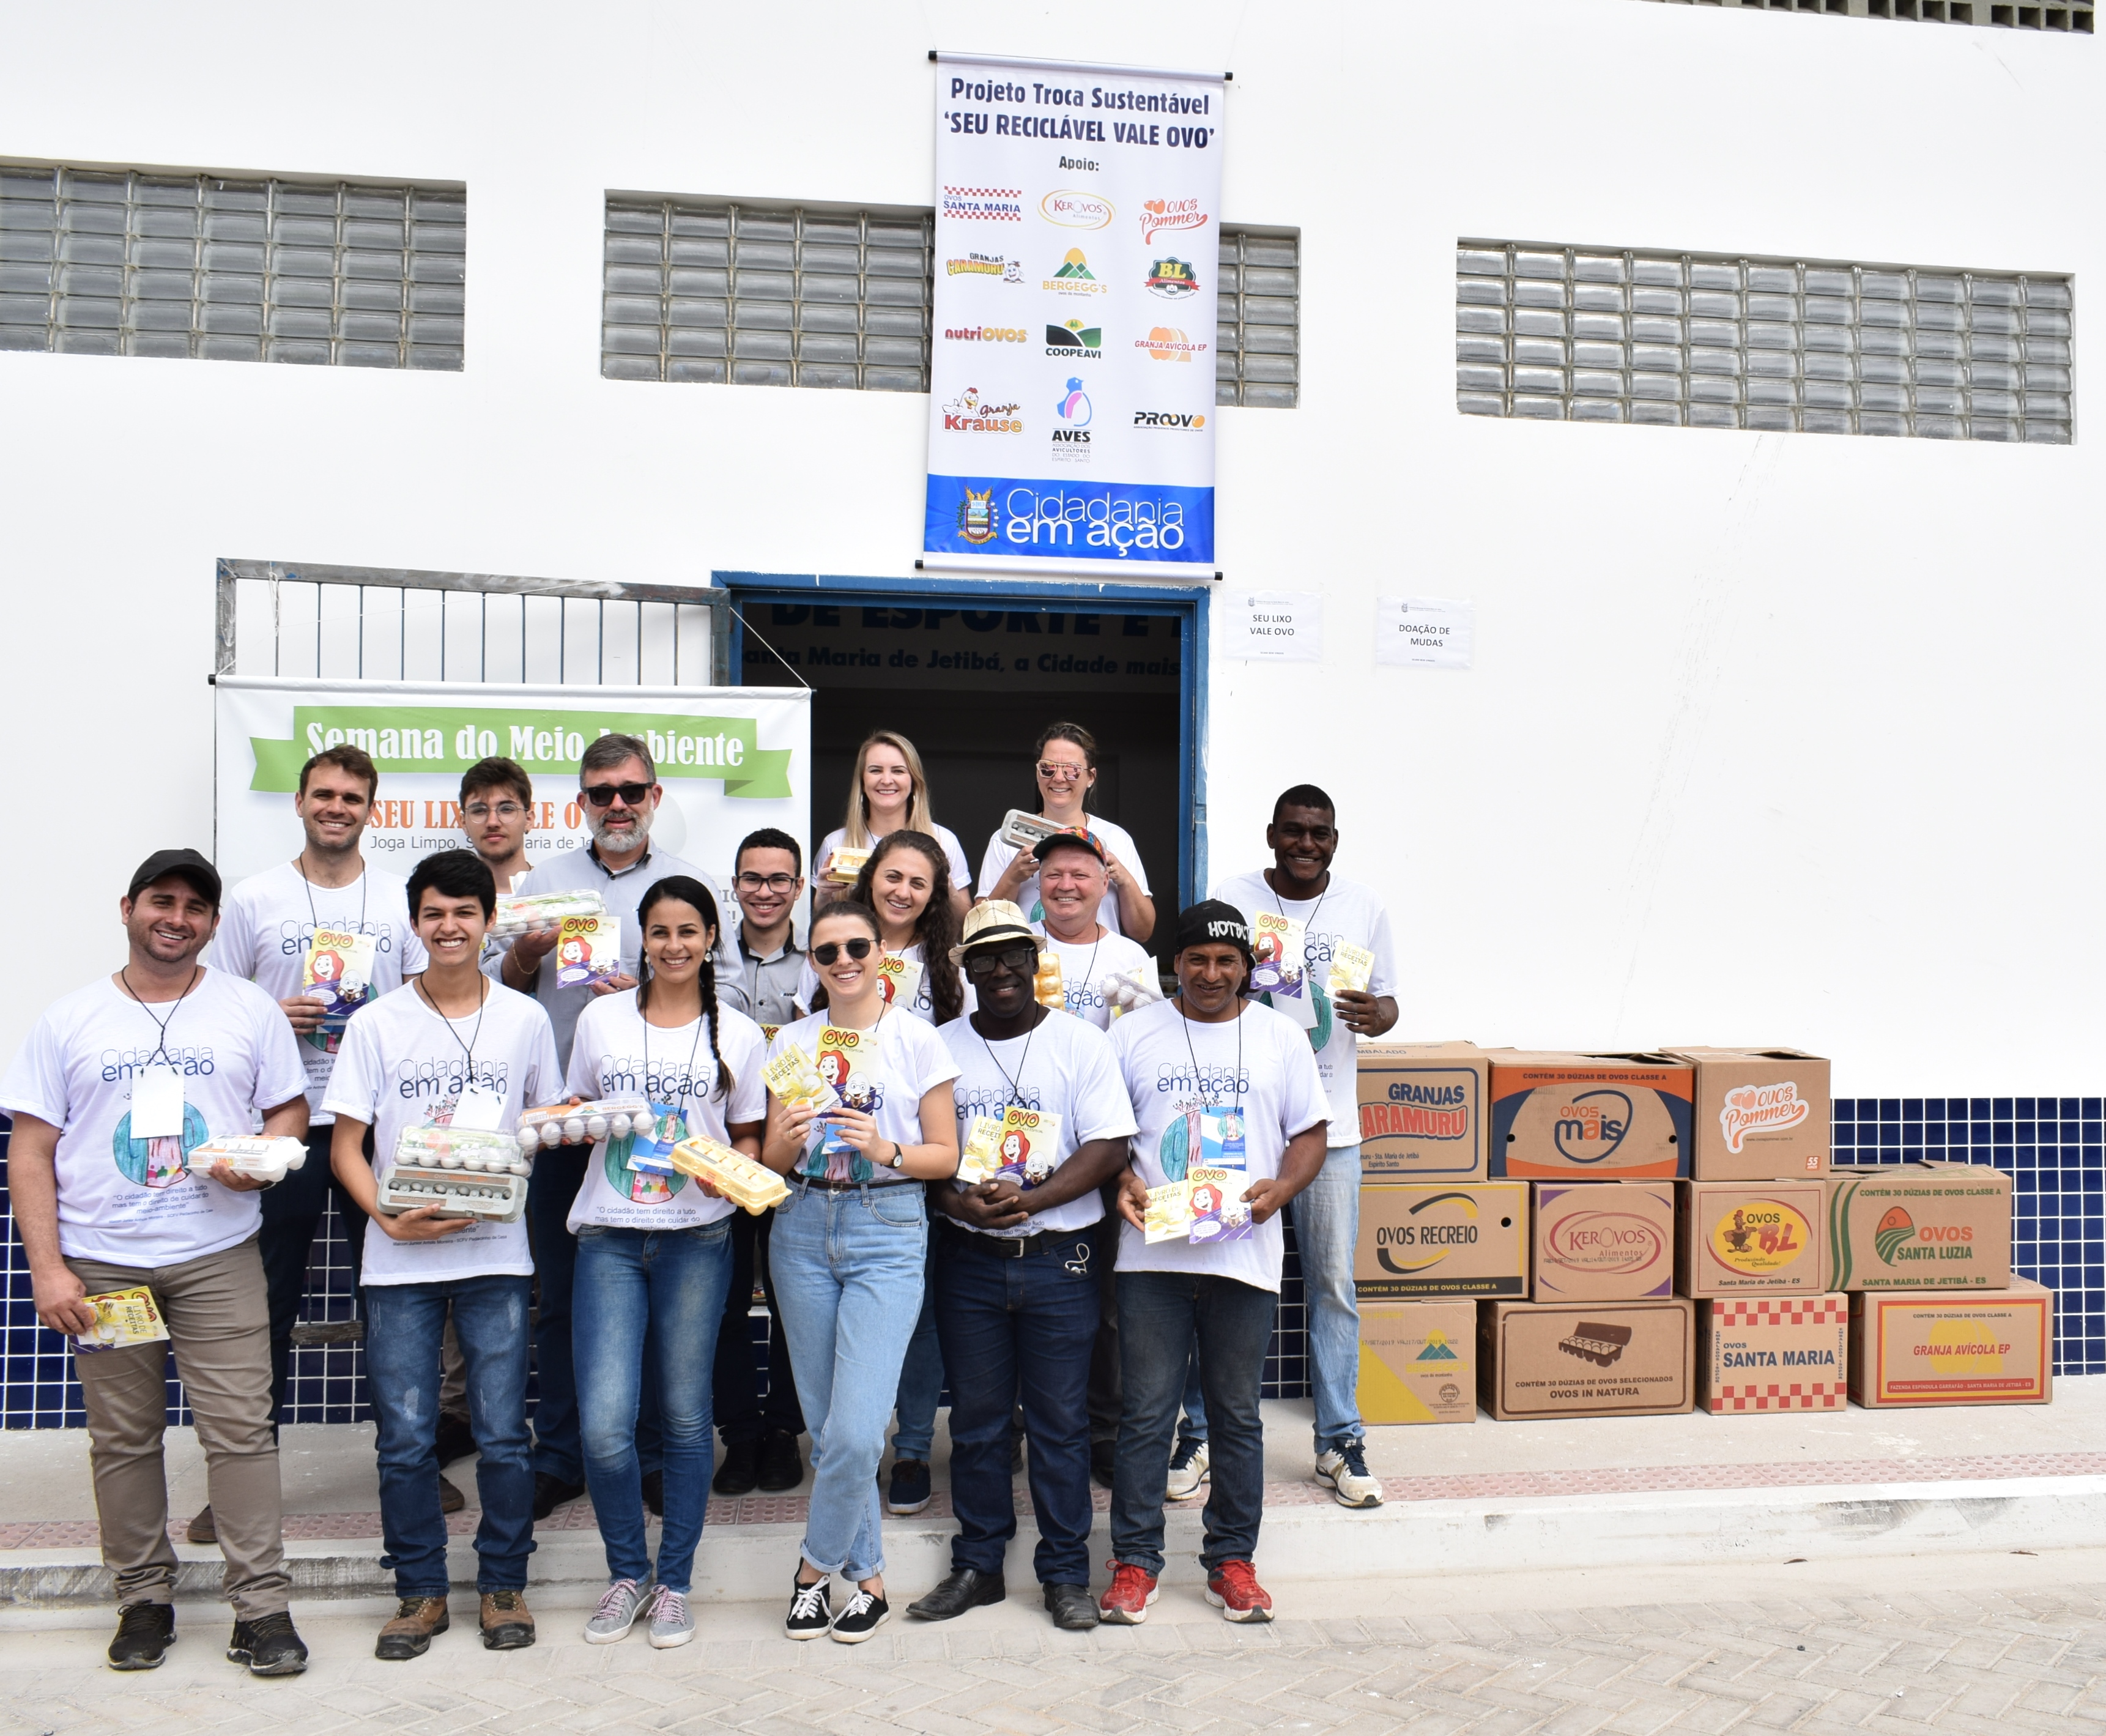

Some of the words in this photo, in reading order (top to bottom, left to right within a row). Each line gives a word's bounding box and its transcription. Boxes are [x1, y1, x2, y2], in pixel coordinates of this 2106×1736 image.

[951, 78, 1025, 103] Projeto
[1033, 83, 1083, 106] Troca
[1091, 87, 1209, 115] Sustentável
[996, 114, 1106, 141] RECICLÁVEL
[1113, 122, 1159, 145] VALE
[1059, 155, 1099, 171] Apoio:
[943, 200, 981, 211] SANTA
[984, 202, 1021, 213] MARIA
[1140, 211, 1207, 236] Pommer
[970, 253, 1004, 263] GRANJAS
[946, 259, 1004, 276] CARAMURU
[1158, 262, 1187, 279] BL
[1045, 347, 1102, 359] COOPEAVI
[1135, 339, 1163, 350] GRANJA
[1165, 340, 1197, 352] AVÍCOLA
[1198, 343, 1207, 352] EP
[944, 414, 1022, 433] Krause
[1051, 430, 1091, 443] AVES
[1007, 488, 1184, 527] Cidadania
[1006, 517, 1073, 544] em
[1087, 517, 1184, 556] ação
[1399, 624, 1437, 635] DOAÇÃO
[1411, 637, 1443, 647] MUDAS
[808, 647, 881, 667] Maria
[888, 650, 919, 668] de
[1037, 653, 1118, 674] Cidade
[1125, 657, 1181, 676] mais
[306, 722, 444, 760] Semana
[455, 724, 498, 759] do
[509, 725, 585, 761] Meio
[371, 799, 415, 829] SEU
[371, 836, 405, 852] Joga
[557, 836, 574, 850] de
[564, 918, 598, 932] OVO
[1259, 914, 1288, 931] OVO
[317, 931, 354, 948] OVO
[1340, 951, 1368, 966] RECEITAS
[1341, 945, 1359, 957] LIVRO
[822, 1029, 859, 1048] OVO
[398, 1055, 508, 1081] Cidadania
[600, 1055, 711, 1083] Cidadania
[766, 1056, 787, 1078] LIVRO
[771, 1058, 800, 1083] RECEITAS
[1157, 1062, 1250, 1081] Cidadania
[399, 1076, 440, 1099] em
[602, 1073, 636, 1092] em
[645, 1073, 710, 1099] ação
[1157, 1077, 1192, 1092] em
[1198, 1075, 1249, 1098] ação
[1389, 1083, 1465, 1105] GRANJAS
[956, 1102, 987, 1120] em
[1007, 1110, 1040, 1127] OVO
[1725, 1101, 1806, 1138] Pommer
[979, 1121, 1001, 1132] LIVRO
[1362, 1104, 1466, 1139] ARAMURU
[1554, 1115, 1623, 1141] mais
[1807, 1156, 1819, 1166] 55
[1192, 1168, 1227, 1182] OVO
[1859, 1188, 1891, 1197] CONTÉM
[1903, 1188, 1931, 1196] DÚZIAS
[1746, 1212, 1781, 1223] OVOS
[1376, 1226, 1415, 1245] OVOS
[1420, 1225, 1478, 1245] RECREIO
[1757, 1223, 1798, 1255] BL
[1919, 1226, 1973, 1242] OVOS
[1897, 1247, 1936, 1261] SANTA
[1939, 1246, 1973, 1259] LUZIA
[1937, 1275, 1968, 1285] JETIBÁ
[125, 1306, 139, 1335] RECEITAS
[133, 1305, 144, 1327] LIVRO
[1913, 1345, 1952, 1356] GRANJA
[1955, 1342, 1995, 1356] AVÍCOLA
[1998, 1344, 2011, 1354] EP
[1723, 1351, 1778, 1368] SANTA
[1782, 1349, 1835, 1366] MARIA
[1549, 1389, 1579, 1399] OVOS
[1582, 1389, 1593, 1398] IN
[1596, 1387, 1640, 1397] NATURA
